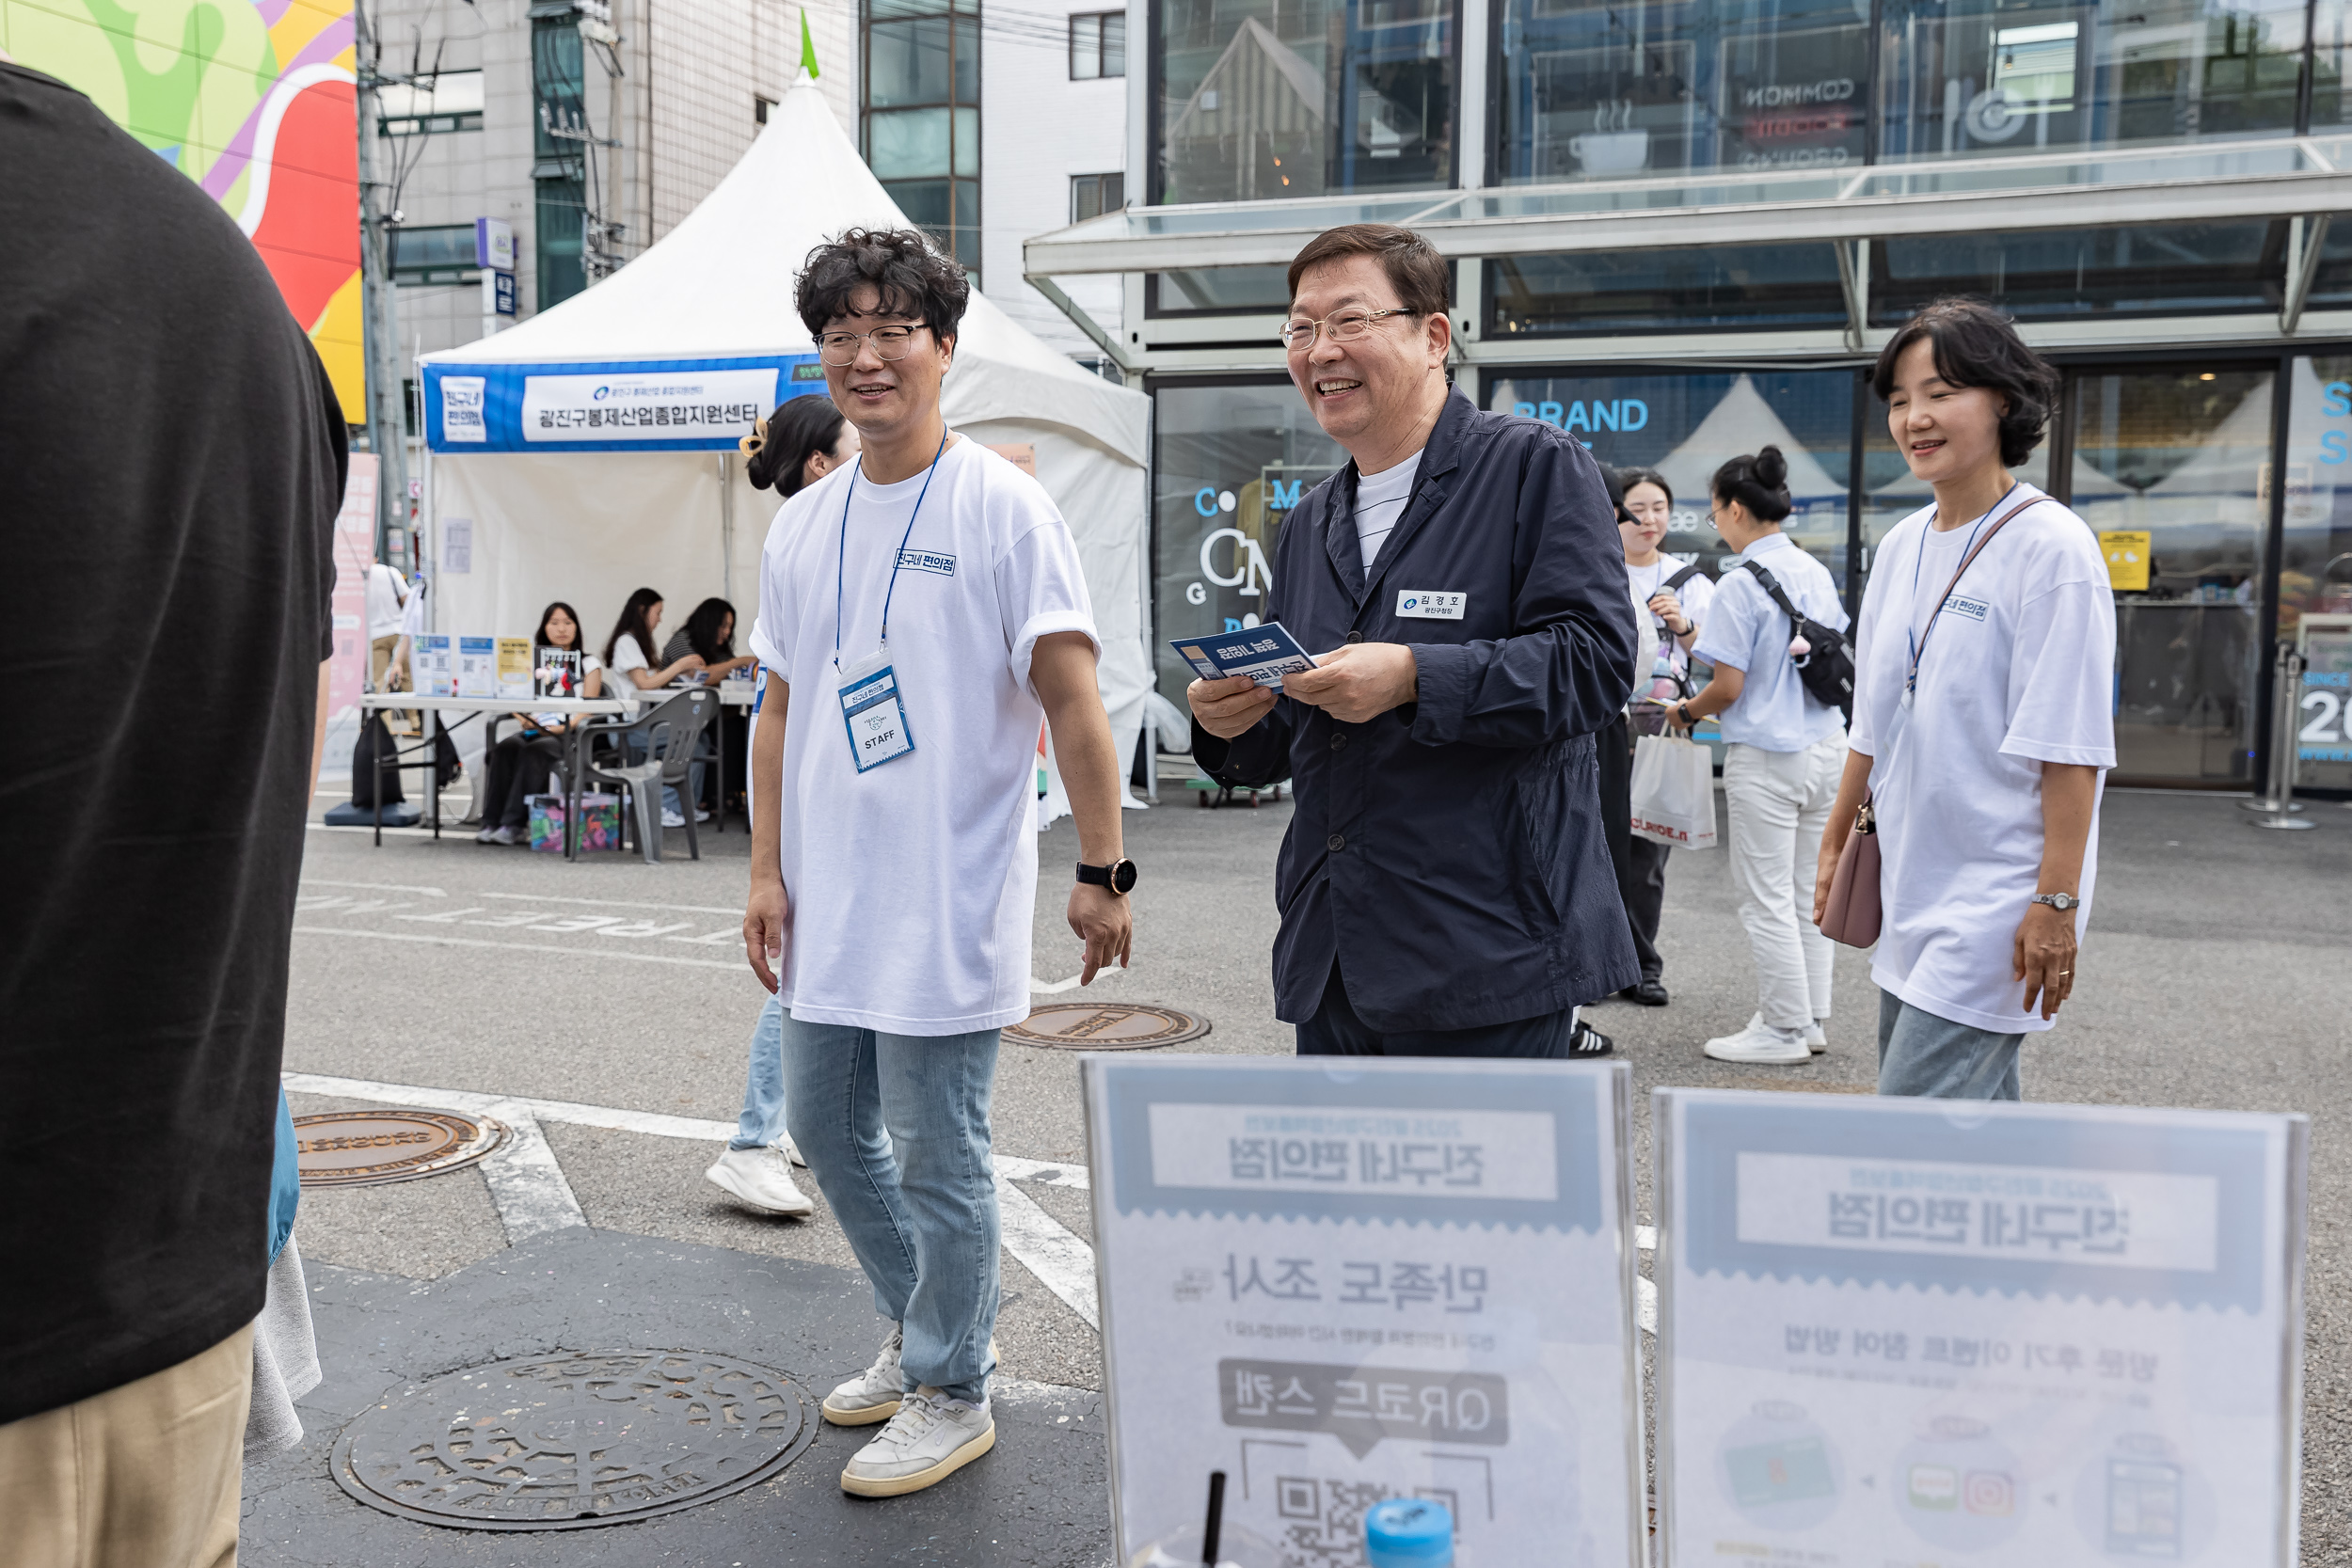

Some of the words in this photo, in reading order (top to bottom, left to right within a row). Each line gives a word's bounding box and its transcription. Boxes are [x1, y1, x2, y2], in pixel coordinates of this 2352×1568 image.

[539, 404, 759, 428] 광진구봉제산업종합지원센터
[1514, 398, 1649, 433] BRAND
[923, 555, 954, 572] 편의점
[1424, 607, 1453, 615] 광진구청장
[1958, 600, 1986, 617] 편의점
[2302, 671, 2349, 687] SINCE
[2297, 690, 2352, 744] 2
[865, 730, 895, 750] STAFF
[393, 908, 747, 947] TREET
